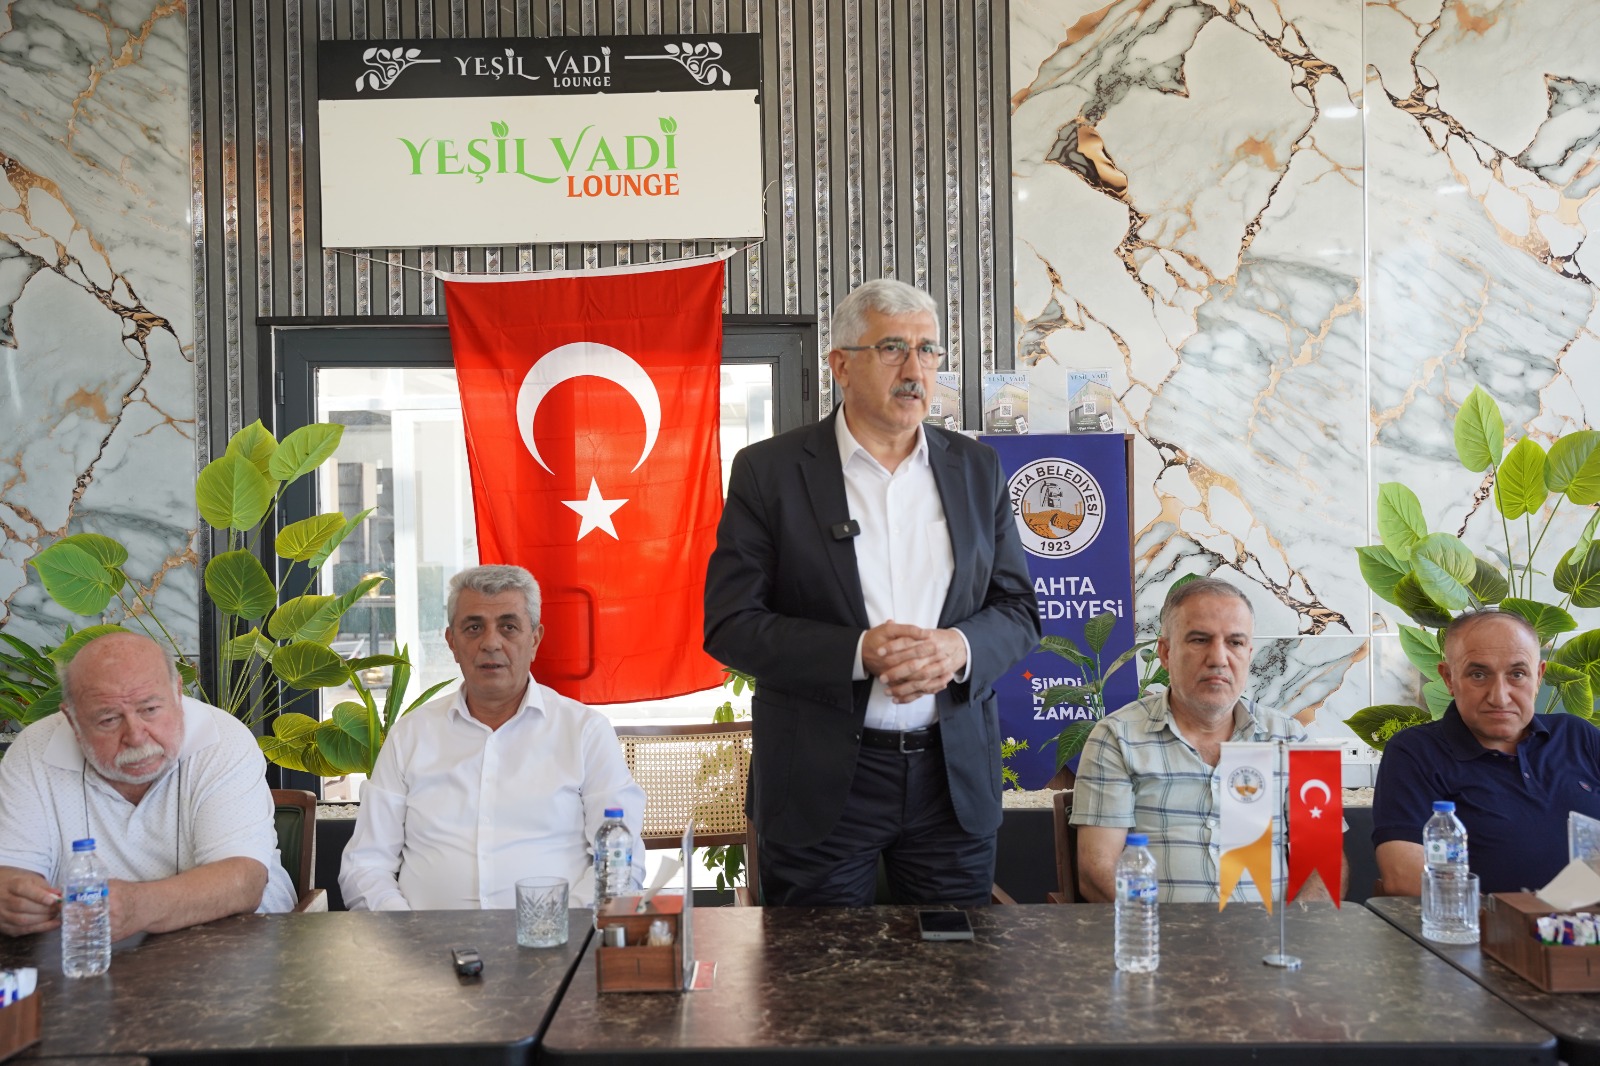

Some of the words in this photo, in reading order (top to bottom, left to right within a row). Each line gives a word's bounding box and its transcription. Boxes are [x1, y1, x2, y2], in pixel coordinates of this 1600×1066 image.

[454, 48, 540, 80] YEŞİL
[545, 46, 611, 75] VADİ
[553, 76, 611, 88] LOUNGE
[397, 120, 561, 184] YEŞİL
[549, 116, 678, 172] VADİ
[566, 173, 680, 198] LOUNGE
[1036, 465, 1100, 517] BELEDİYESİ
[1040, 540, 1071, 551] 1923
[1034, 576, 1097, 596] AHTA
[1037, 600, 1124, 619] EDİYESİ
